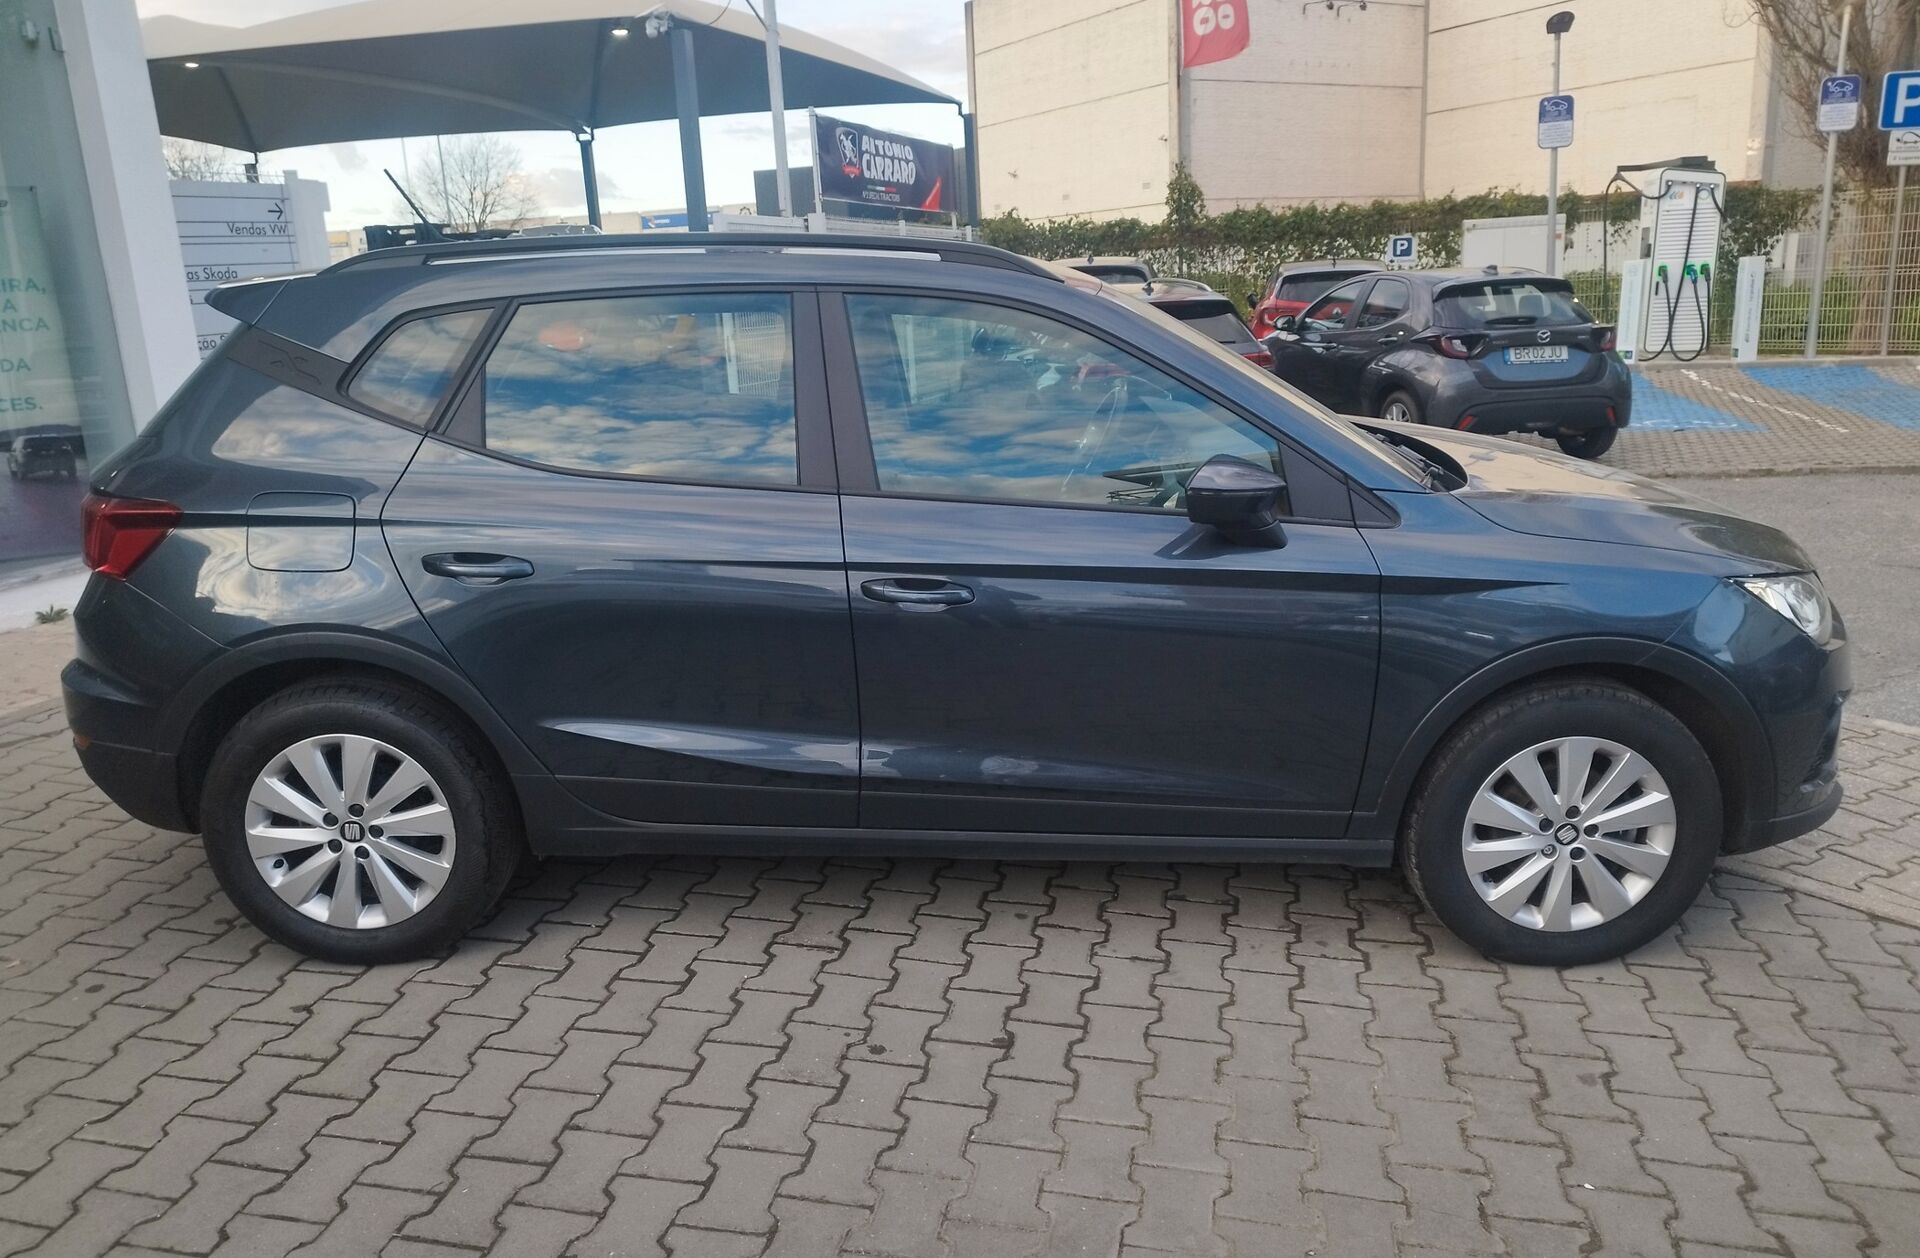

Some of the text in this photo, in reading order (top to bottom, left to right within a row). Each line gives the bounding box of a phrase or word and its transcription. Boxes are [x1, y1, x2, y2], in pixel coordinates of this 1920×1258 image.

[1893, 77, 1920, 123] P
[862, 135, 914, 161] ANTONIO
[862, 153, 917, 185] CARRARO
[226, 221, 288, 236] Vendas VW
[1396, 240, 1409, 255] P
[203, 266, 239, 280] Skoda
[0, 277, 46, 295] IRA,
[2, 298, 17, 313] A
[0, 317, 50, 333] NCA
[1514, 345, 1562, 359] BR 02 JU
